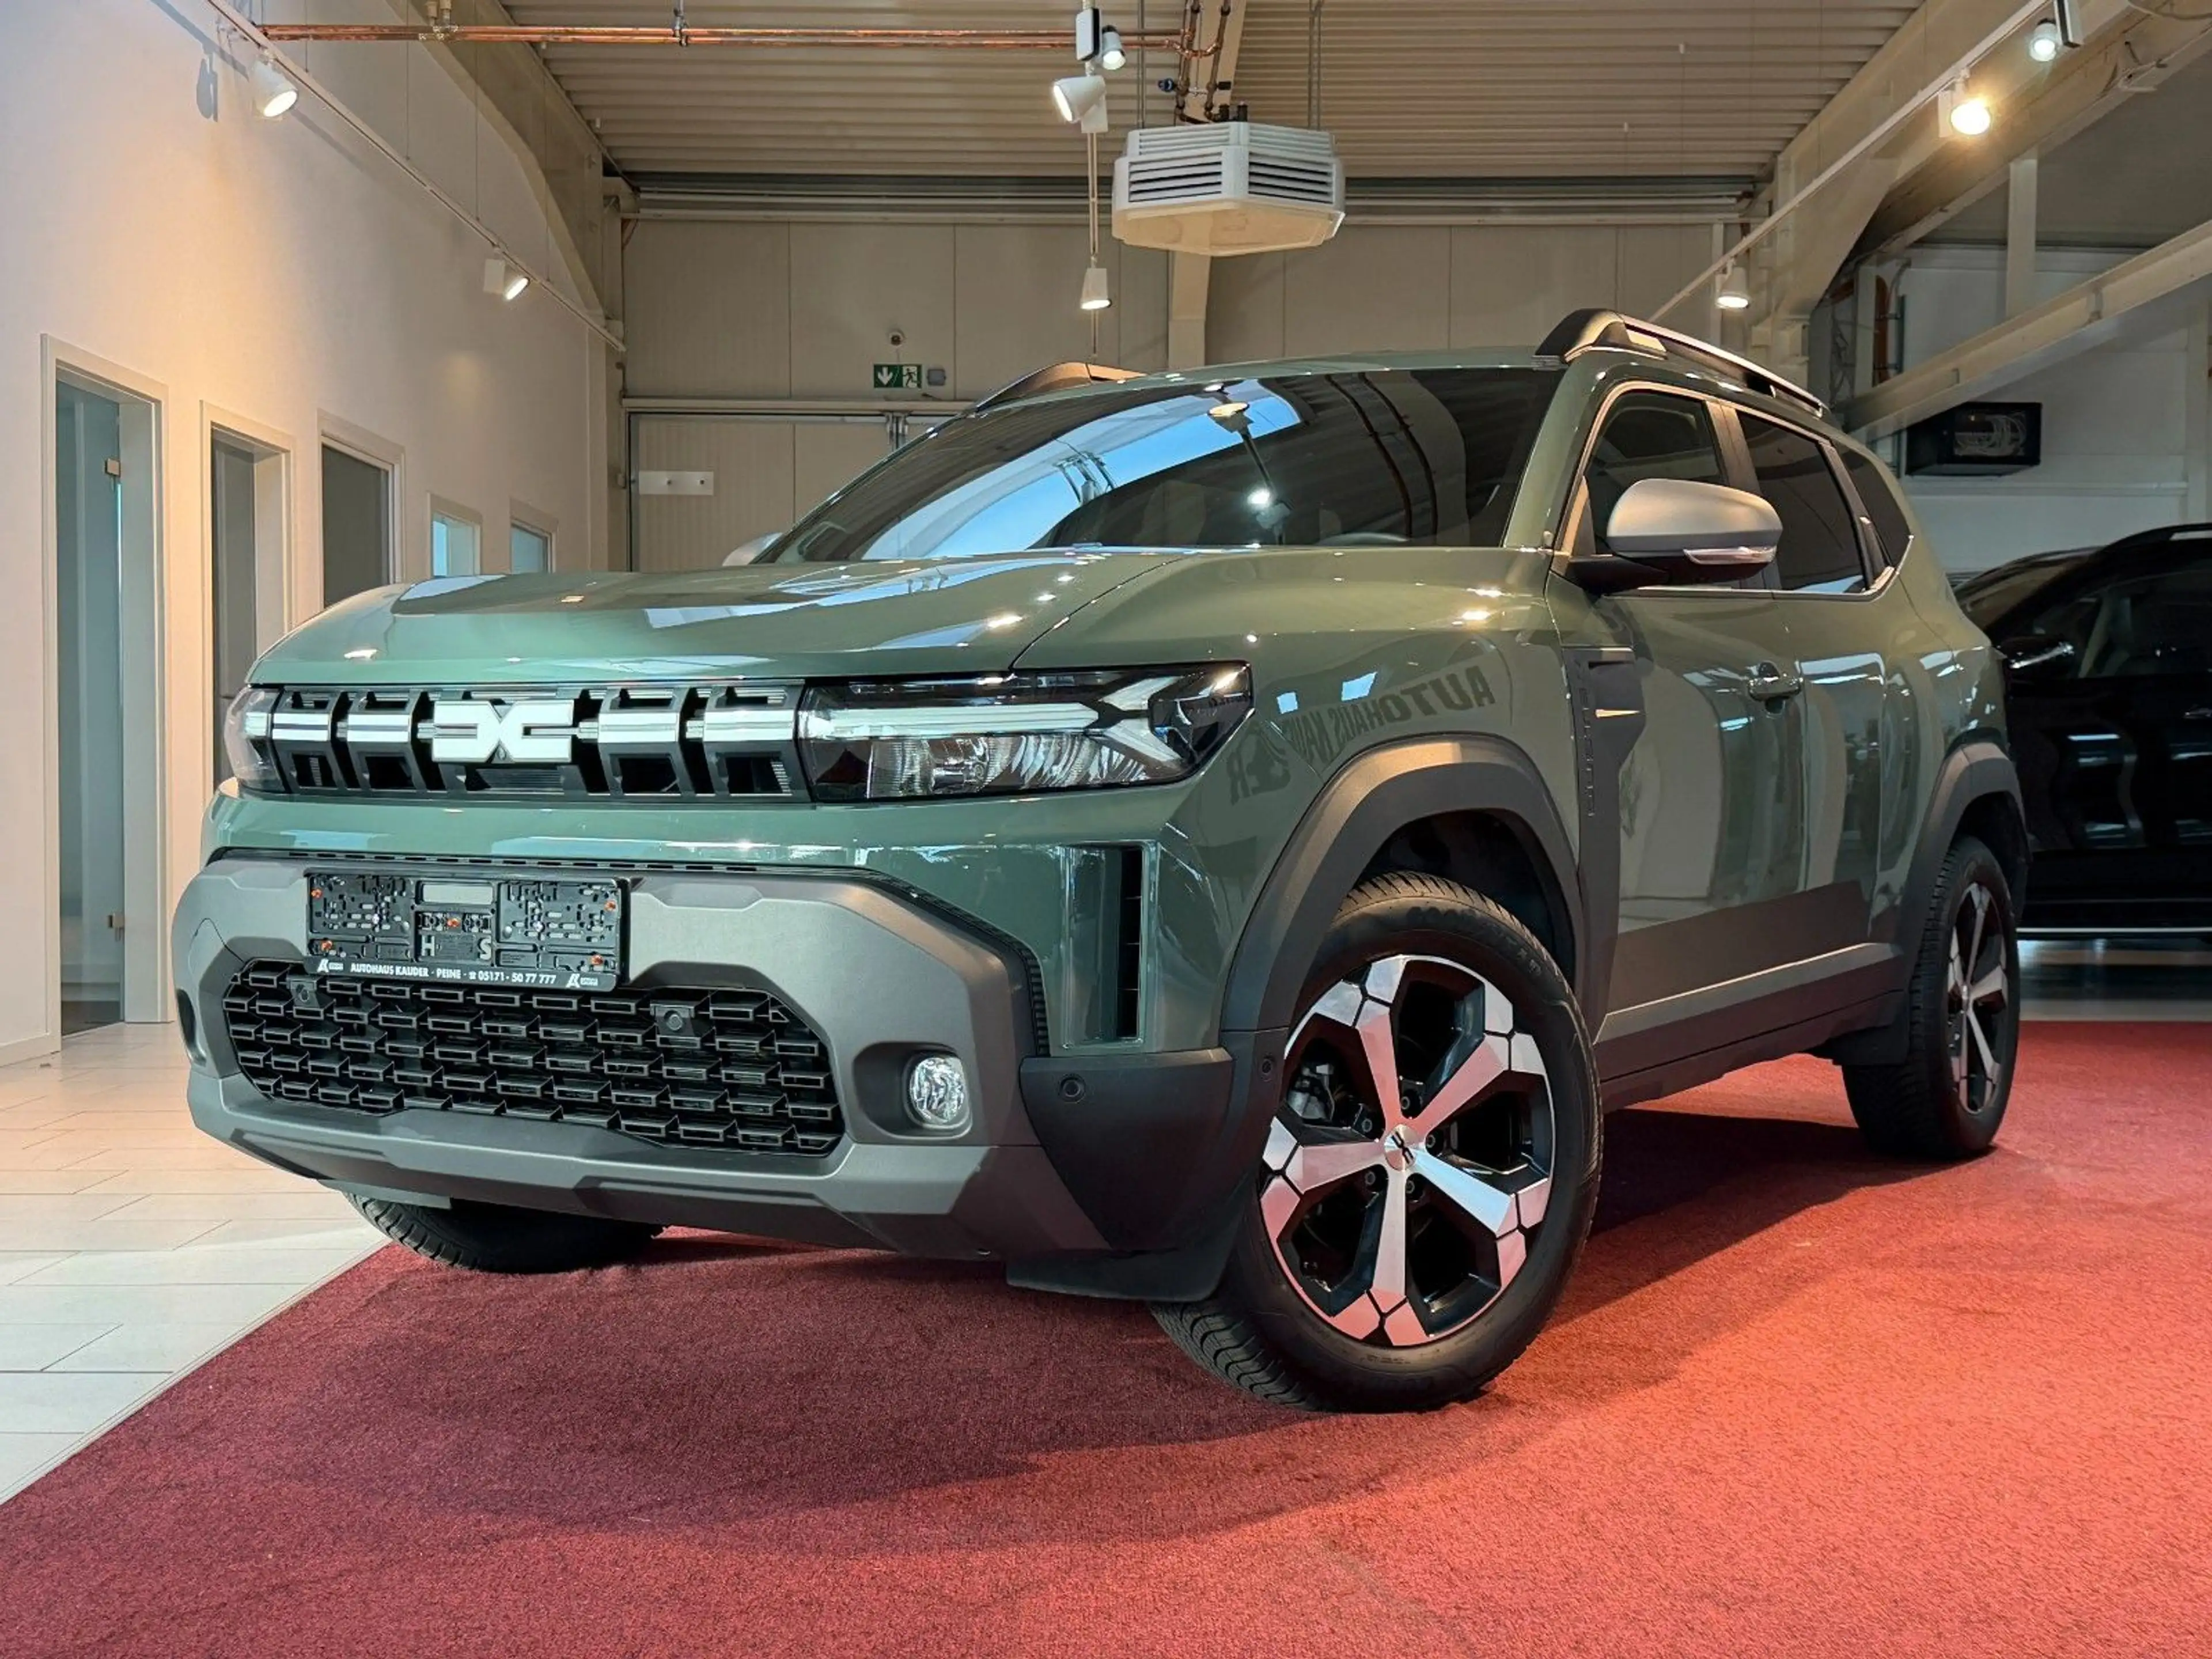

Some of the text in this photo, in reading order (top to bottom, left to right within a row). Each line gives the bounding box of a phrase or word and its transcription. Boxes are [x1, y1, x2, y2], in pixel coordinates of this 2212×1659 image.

[350, 963, 394, 975] AUTOHAUS
[395, 965, 429, 978] KAUDER
[436, 968, 461, 979] PEINE
[478, 970, 504, 981] 05171
[525, 973, 537, 983] 77
[539, 974, 557, 984] 777
